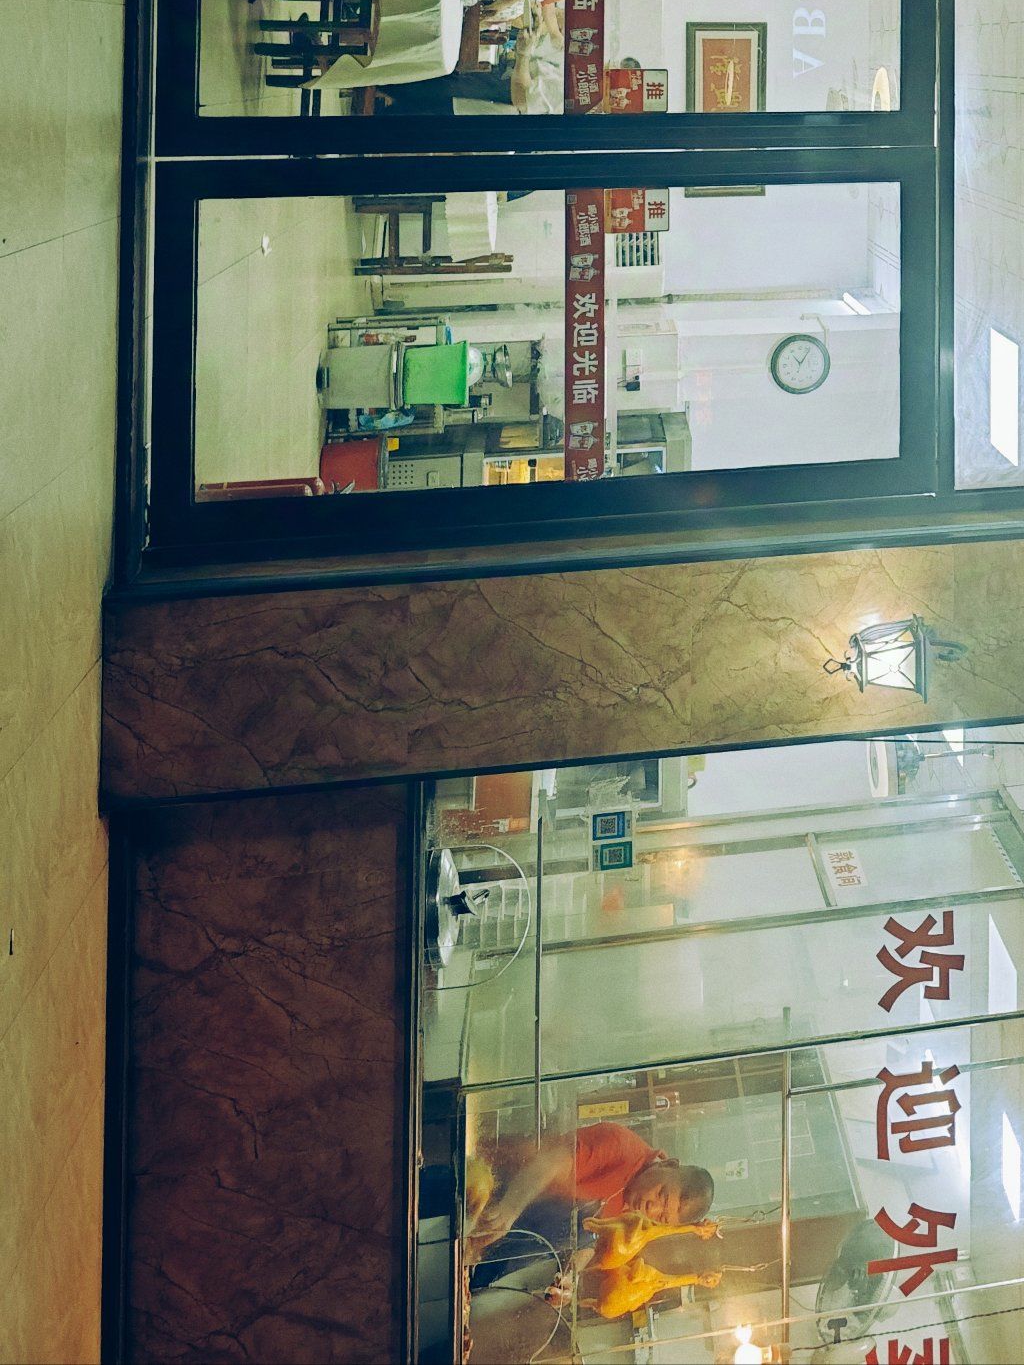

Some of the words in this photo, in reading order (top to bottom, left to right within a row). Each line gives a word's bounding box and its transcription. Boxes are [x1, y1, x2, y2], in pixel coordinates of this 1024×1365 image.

[576, 71, 591, 105] 小郎酒
[646, 82, 665, 100] 推
[647, 201, 666, 219] 推
[576, 212, 592, 246] 小郎酒
[572, 292, 600, 404] 欢迎光临
[828, 851, 861, 886] 熟食间
